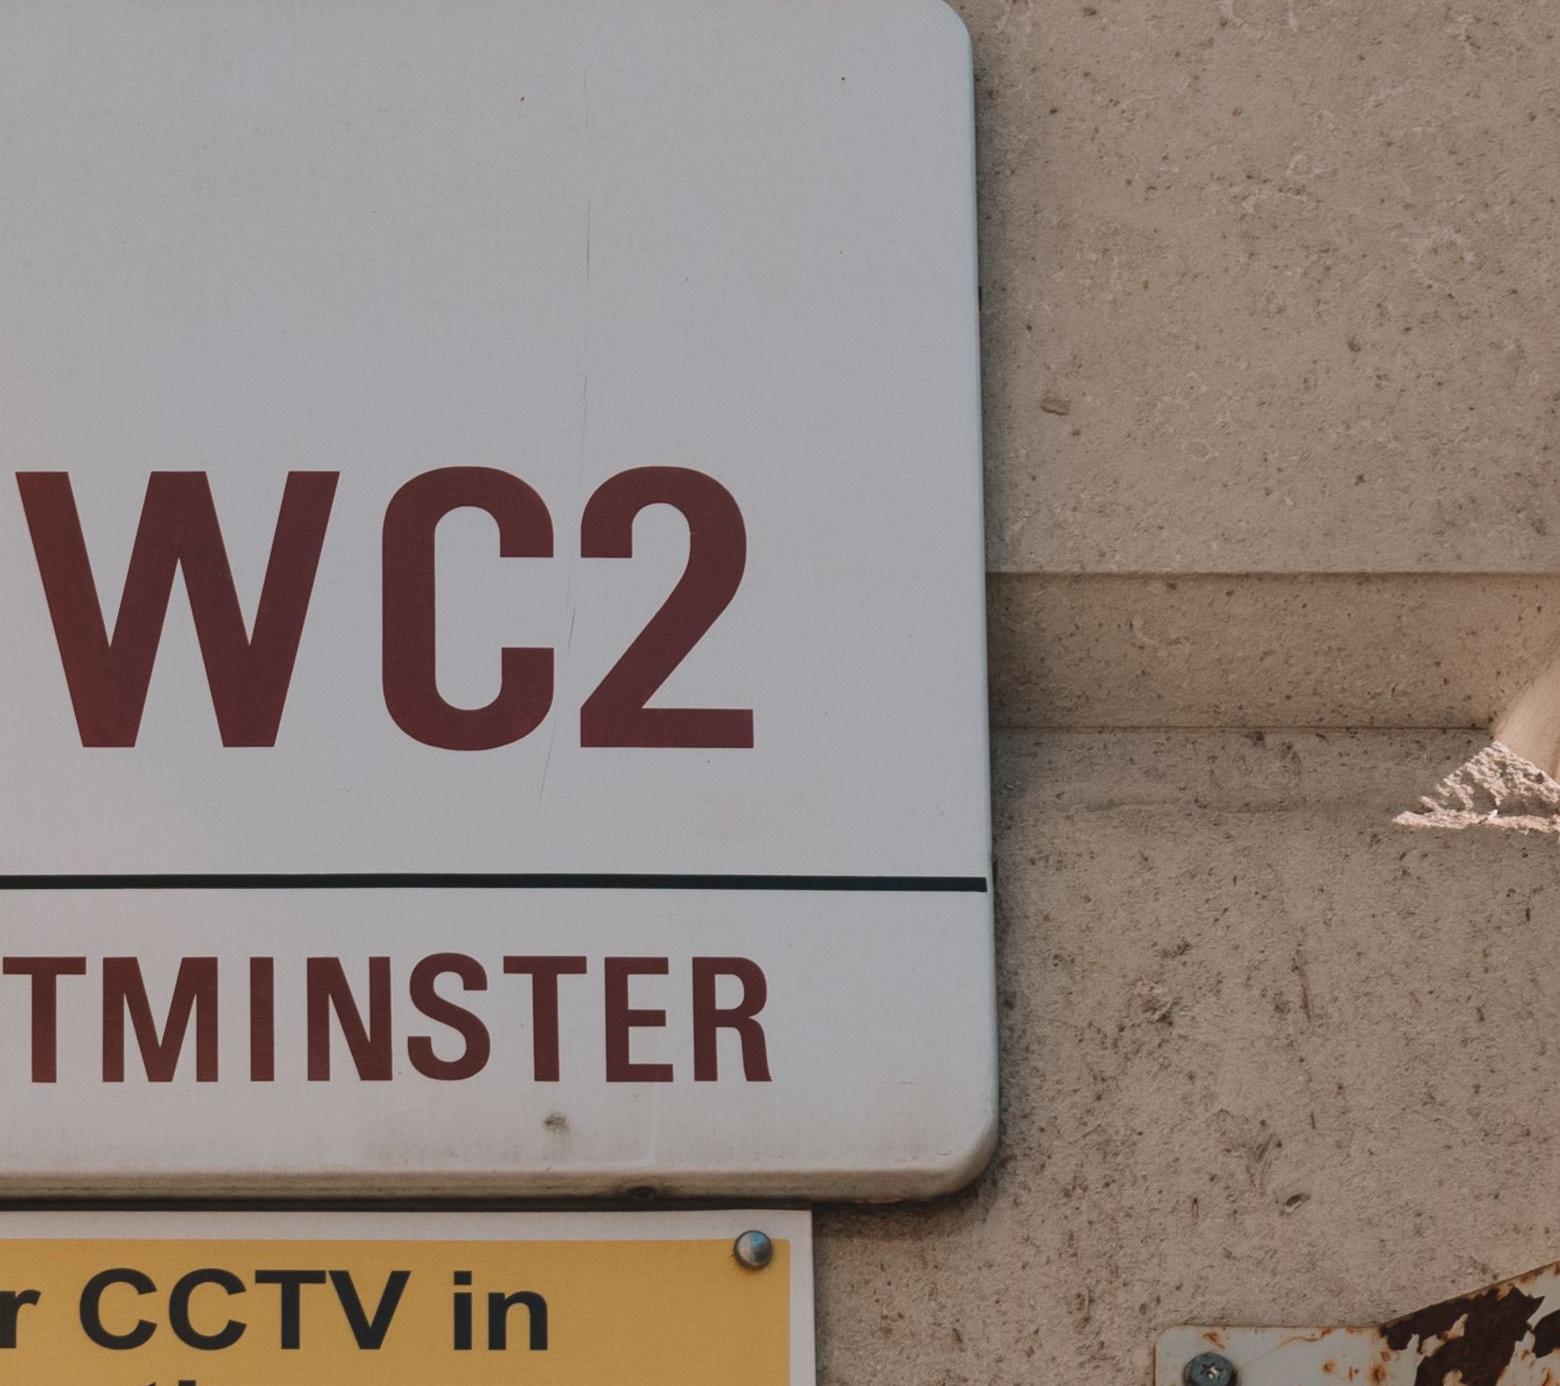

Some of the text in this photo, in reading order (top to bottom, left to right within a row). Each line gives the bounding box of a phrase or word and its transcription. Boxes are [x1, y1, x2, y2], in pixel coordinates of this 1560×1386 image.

[15, 465, 755, 752] WC2
[79, 1267, 412, 1351] CCTV
[453, 1270, 549, 1351] in
